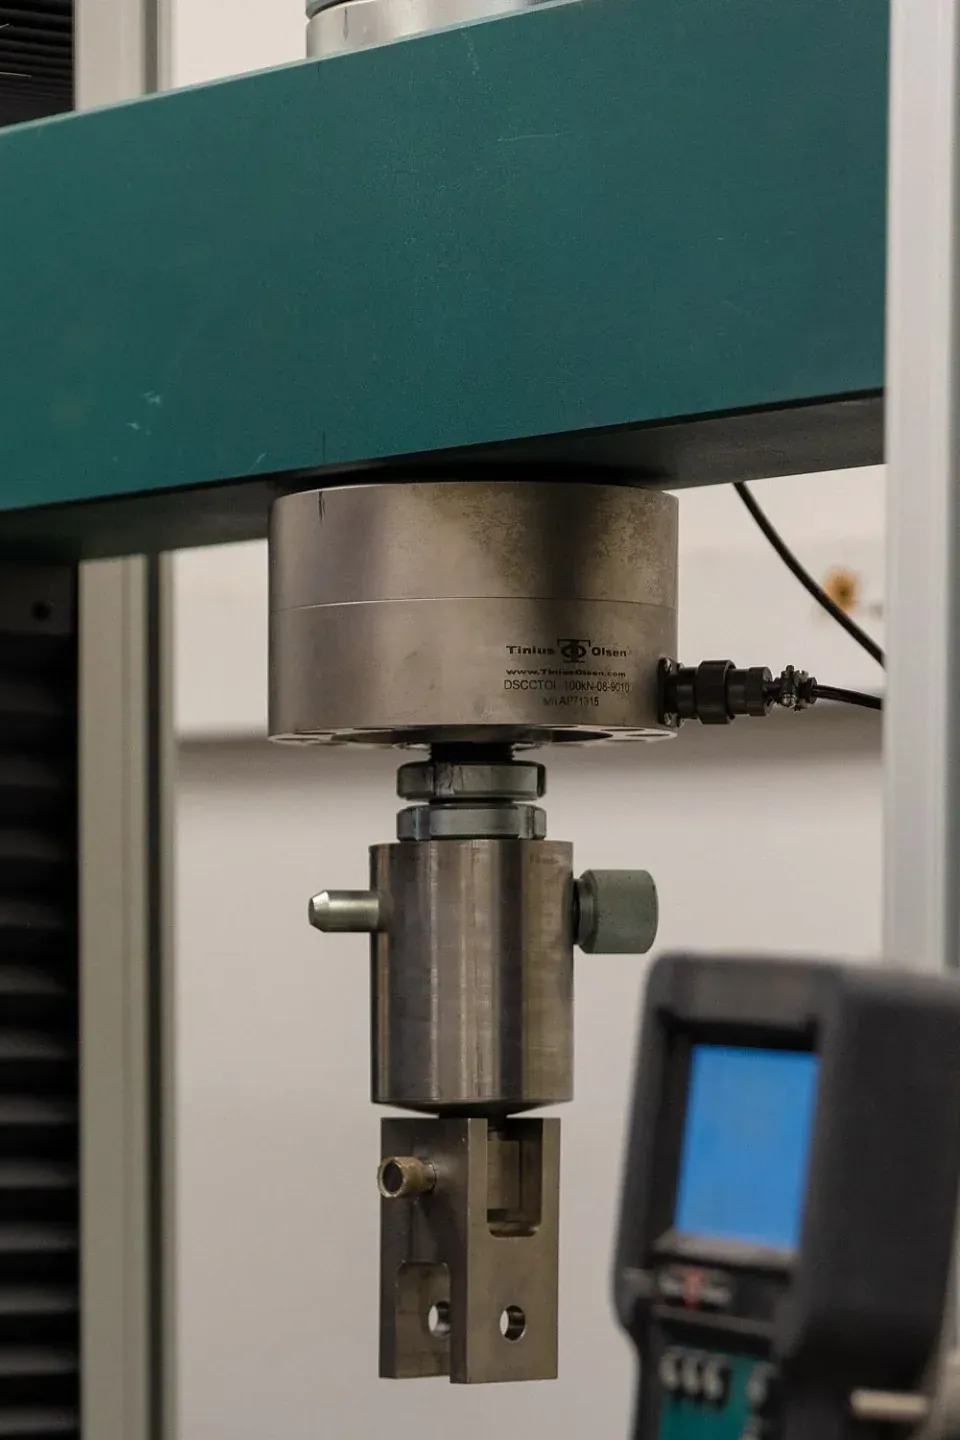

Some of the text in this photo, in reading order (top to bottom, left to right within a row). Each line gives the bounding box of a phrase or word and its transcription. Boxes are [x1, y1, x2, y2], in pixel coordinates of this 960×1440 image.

[506, 645, 627, 657] Tinius Olsen
[505, 668, 626, 677] www.TiniusOlsen.com
